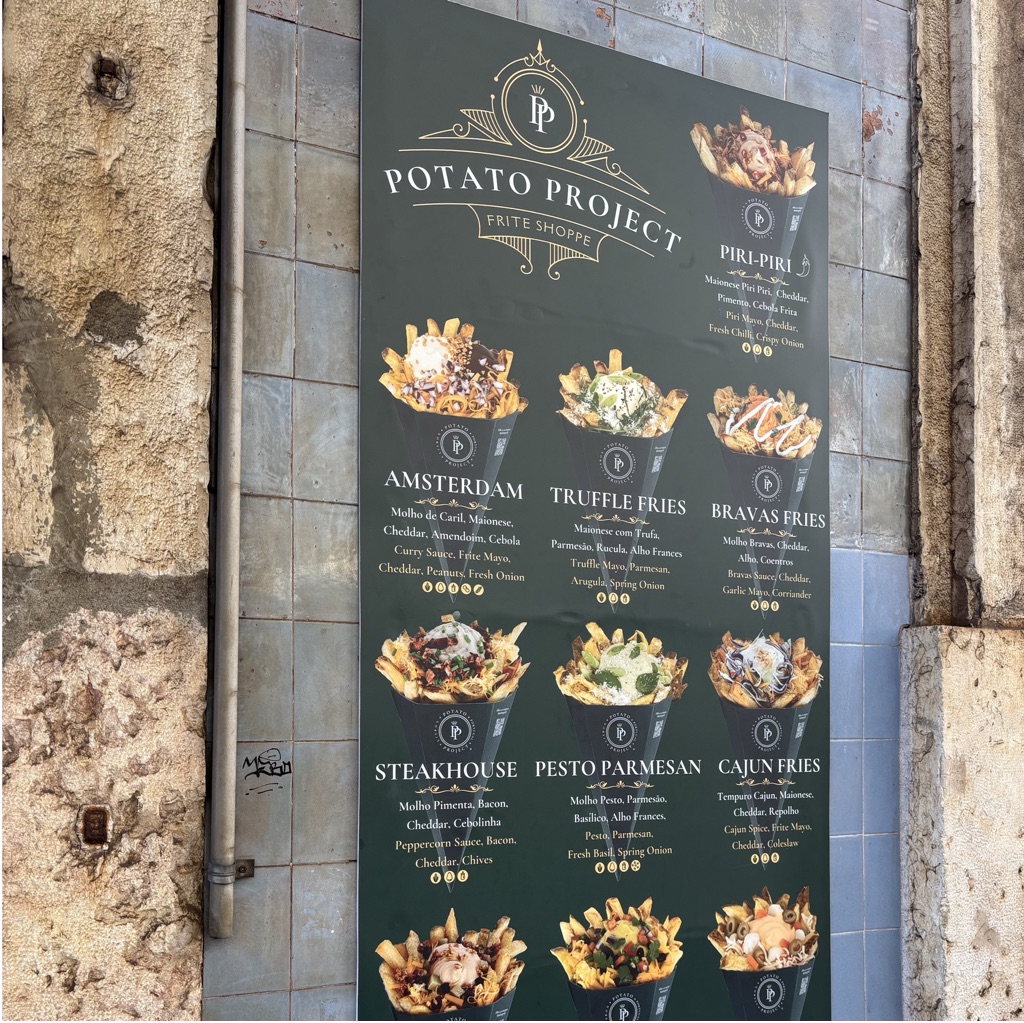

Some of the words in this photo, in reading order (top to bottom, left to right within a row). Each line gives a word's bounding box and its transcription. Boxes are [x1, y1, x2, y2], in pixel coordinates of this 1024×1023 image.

[384, 165, 531, 195] POTATO
[545, 178, 682, 253] PROJECT
[487, 215, 531, 229] FRITE
[536, 221, 592, 247] SHOPPE
[720, 244, 791, 273] PIRI-PIRI
[705, 275, 740, 289] Maionese
[742, 283, 755, 292] Piri
[753, 301, 778, 312] Cebola
[781, 307, 797, 316] Frita
[726, 311, 739, 320] Piri
[709, 324, 729, 334] Fresh
[756, 333, 779, 346] Crispy
[782, 338, 804, 348] Onion
[384, 470, 523, 499] AMSTERDAM
[550, 487, 632, 510] TRUFFLE
[638, 496, 686, 515] FRIES
[391, 507, 422, 519] Molho
[425, 510, 437, 520] de
[440, 512, 465, 523] Caril,
[469, 514, 513, 527] Maionese,
[712, 503, 779, 523] BRAVAS
[784, 511, 825, 528] FRIES
[384, 525, 428, 538] Cheddar,
[431, 530, 486, 543] Amendoim,
[489, 535, 520, 546] Cebola
[574, 524, 613, 535] Maionese
[723, 536, 747, 546] Molho
[777, 541, 809, 552] Cheddar,
[394, 545, 423, 559] Curry
[427, 548, 455, 559] Sauce,
[459, 550, 480, 560] Frite
[484, 552, 510, 565] Mayo,
[630, 546, 650, 555] Alho
[653, 548, 682, 558] Frances
[570, 558, 600, 568] Truffle
[761, 556, 793, 566] Coentros
[379, 563, 423, 575] Cheddar,
[469, 569, 493, 579] Fresh
[496, 571, 525, 581] Onion
[728, 570, 752, 579] Bravas
[610, 579, 637, 591] Spring
[639, 581, 665, 590] Onion
[723, 586, 746, 595] Garlic
[772, 589, 811, 599] Corriander
[443, 745, 469, 753] PROJECT
[376, 762, 517, 780] STEAKHOUSE
[536, 760, 596, 777] PESTO
[602, 760, 701, 775] PARMESAN
[718, 759, 773, 778] CAJUN
[778, 758, 820, 773] FRIES
[570, 795, 597, 805] Molho
[601, 796, 624, 805] Pesto,
[717, 792, 752, 803] Tempuro
[399, 801, 430, 811] Molho
[478, 799, 508, 809] Bacon,
[611, 812, 631, 821] Alho
[769, 806, 799, 818] Repolho
[407, 819, 450, 830] Cheddar,
[454, 816, 501, 828] Cebolinha
[724, 825, 746, 836] Cajun
[772, 823, 789, 831] Frite
[613, 830, 653, 839] Parmesan,
[395, 839, 451, 853] Peppercorn
[455, 838, 483, 847] Sauce,
[487, 836, 516, 845] Bacon,
[767, 838, 799, 849] Coleslaw
[568, 849, 590, 859] Fresh
[618, 847, 644, 859] Spring
[647, 846, 672, 855] Onion
[462, 855, 493, 865] Chives
